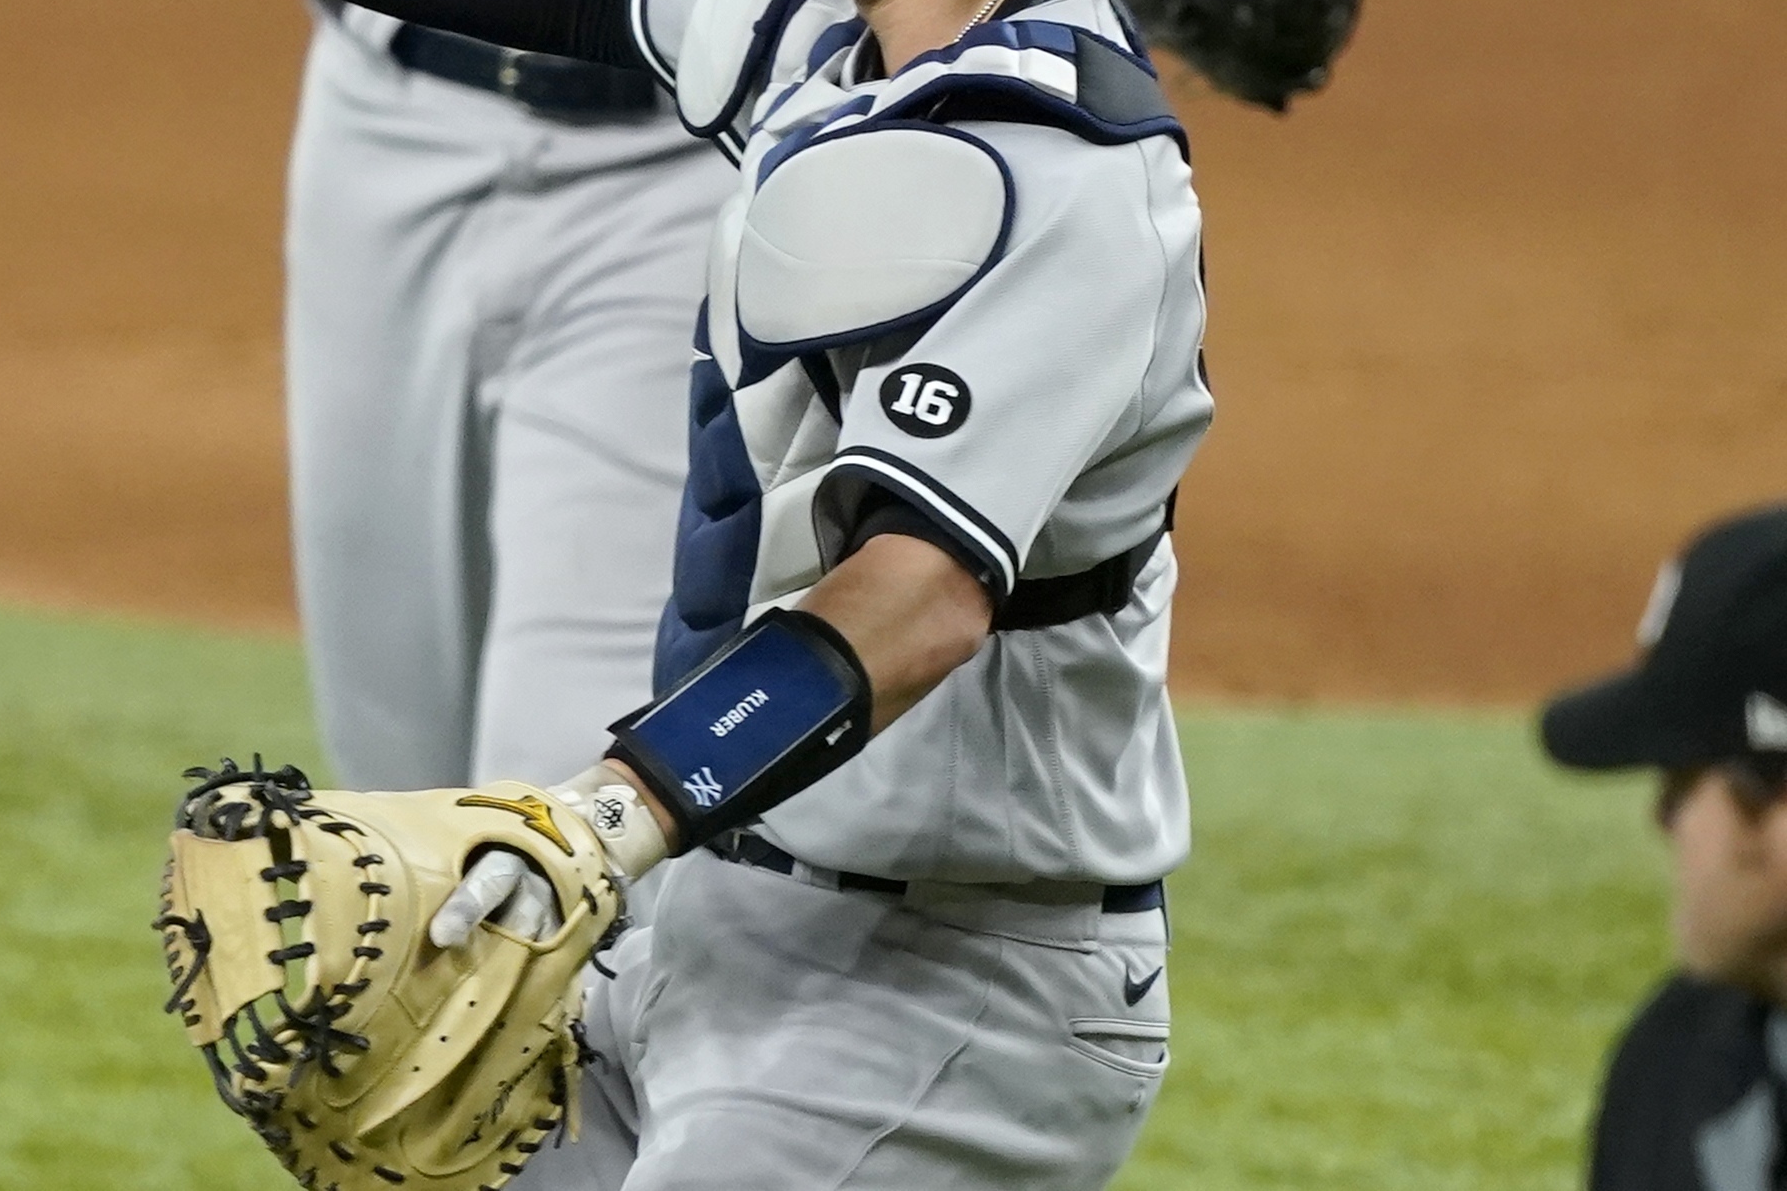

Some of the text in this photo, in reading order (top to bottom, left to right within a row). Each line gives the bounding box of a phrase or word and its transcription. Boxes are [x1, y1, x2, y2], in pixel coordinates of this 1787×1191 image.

[891, 373, 959, 425] 16
[709, 689, 769, 737] KLUBER
[683, 766, 723, 807] NY
